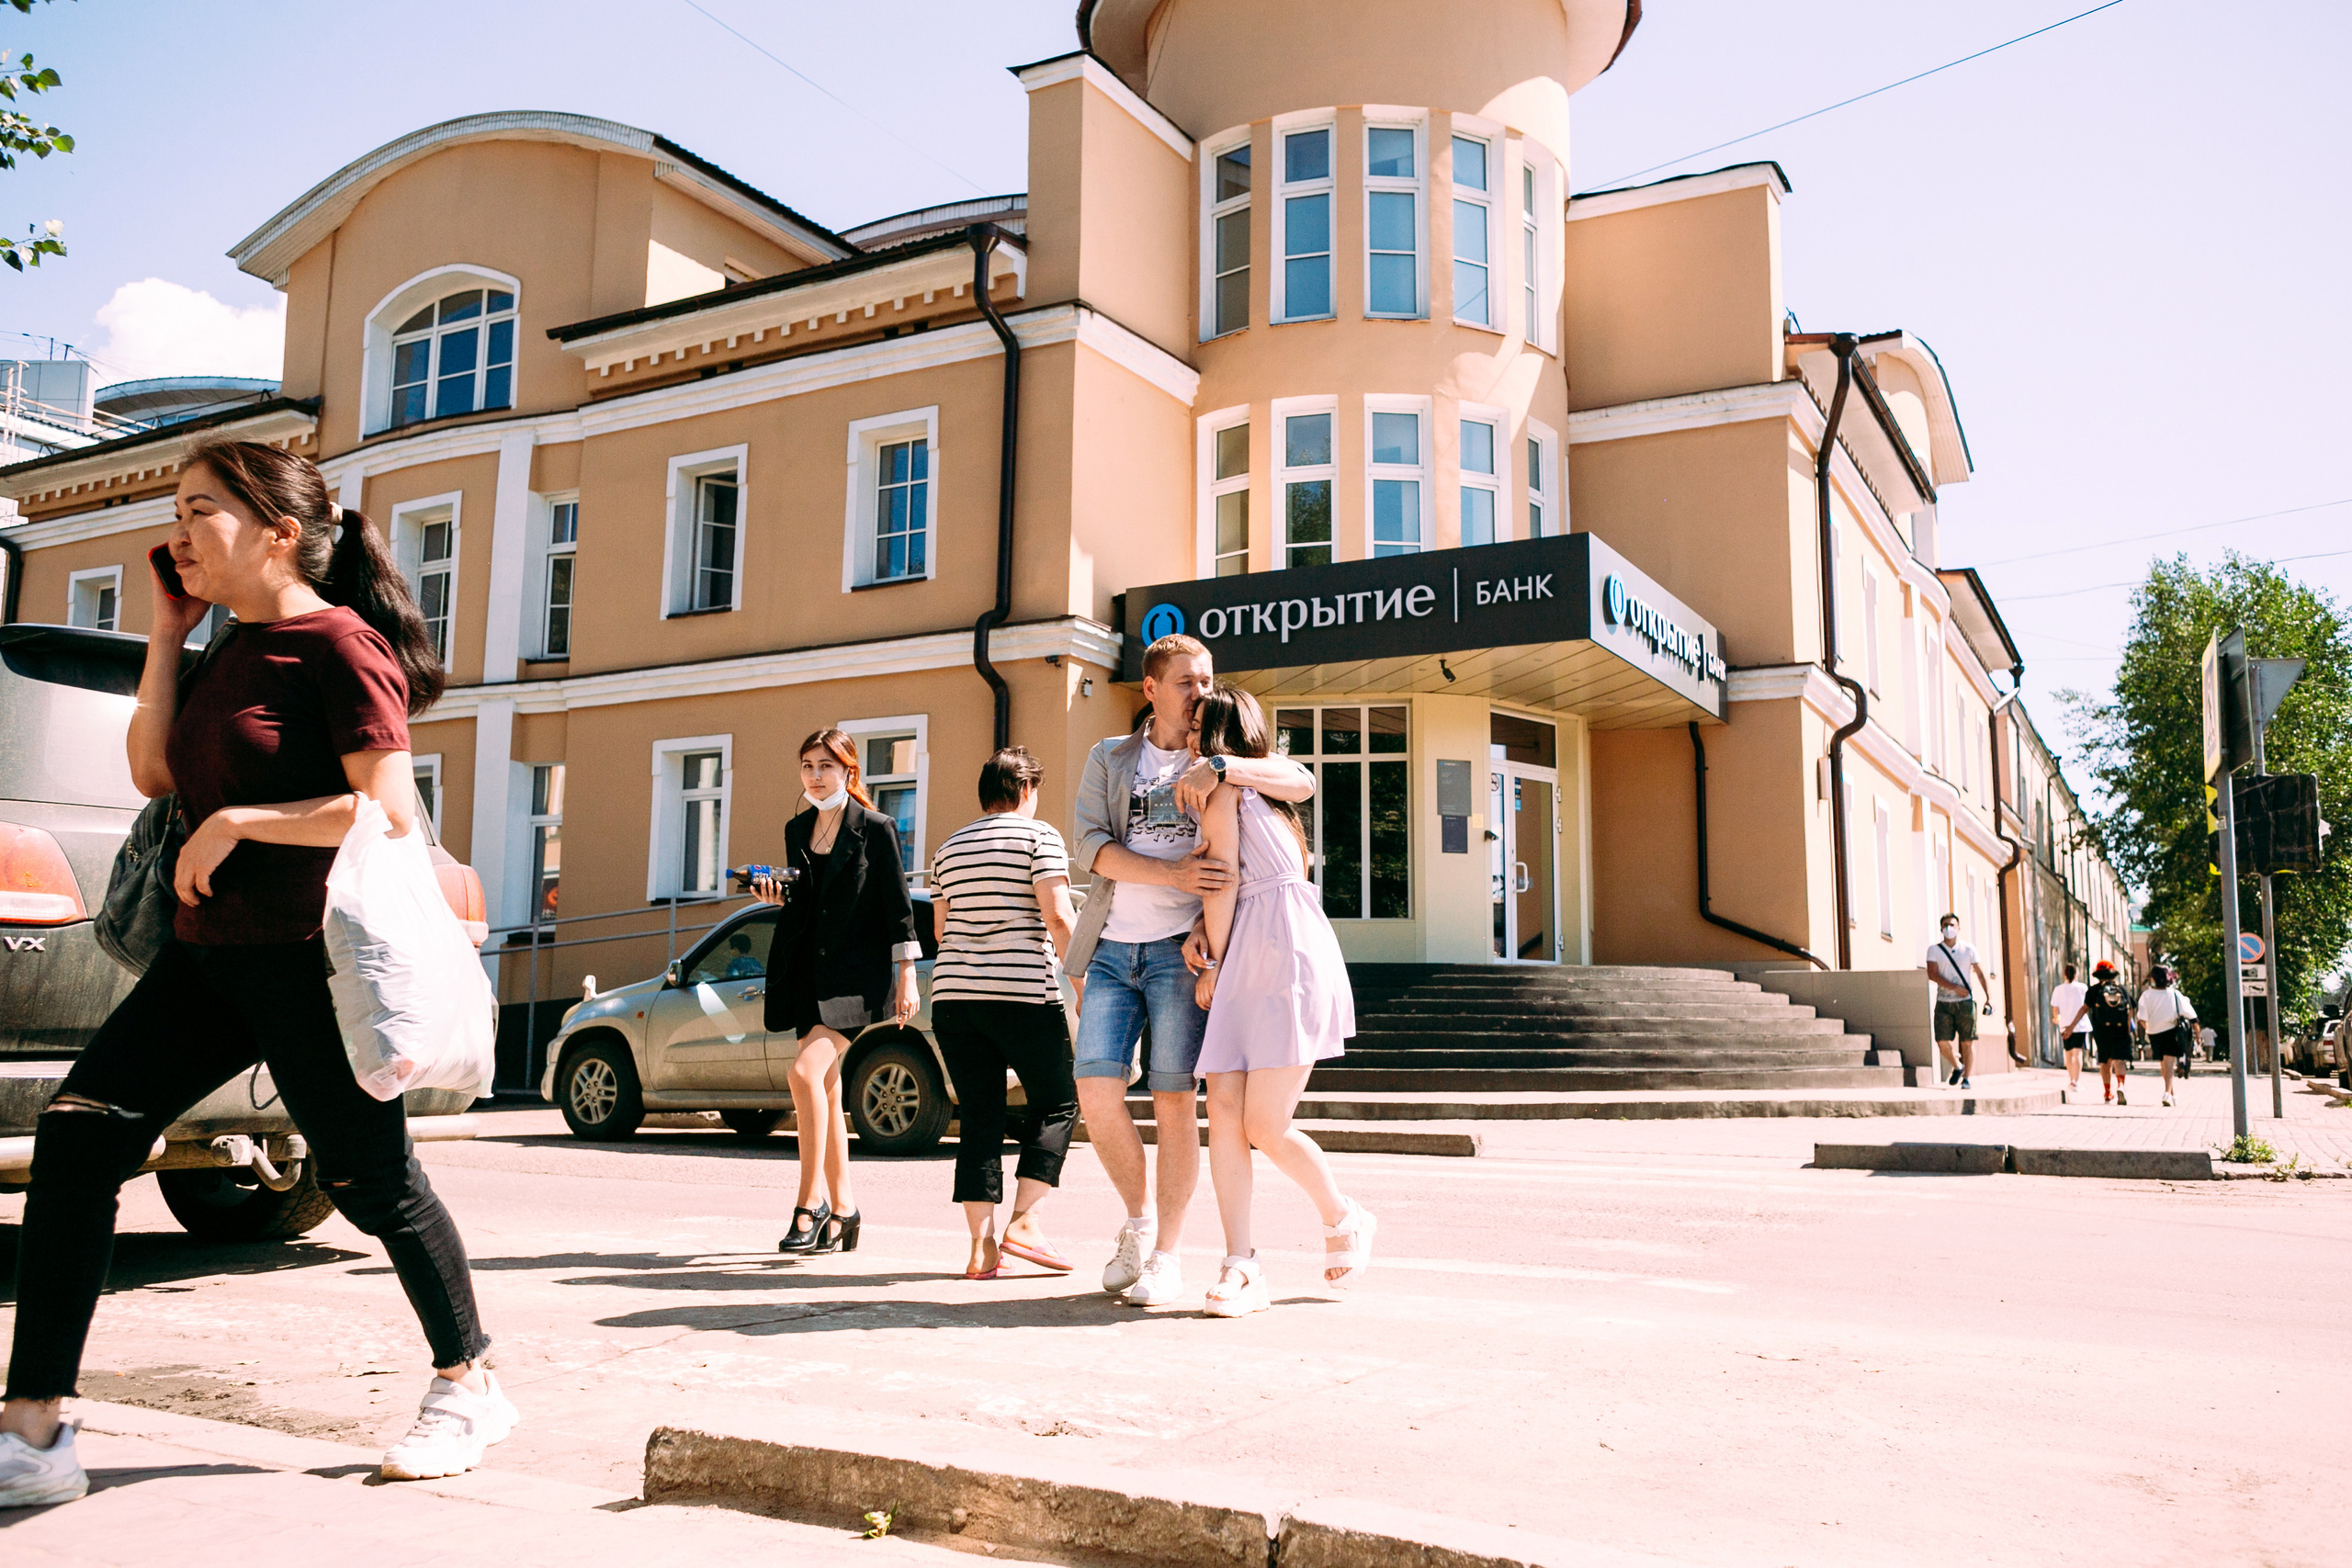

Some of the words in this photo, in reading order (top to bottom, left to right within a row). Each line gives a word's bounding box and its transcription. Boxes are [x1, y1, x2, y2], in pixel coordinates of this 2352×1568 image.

[1198, 584, 1436, 644] открытие
[1476, 573, 1554, 605] БАНК
[1630, 594, 1702, 669] открытие
[1708, 651, 1727, 682] БАНК
[3, 936, 46, 952] VX
